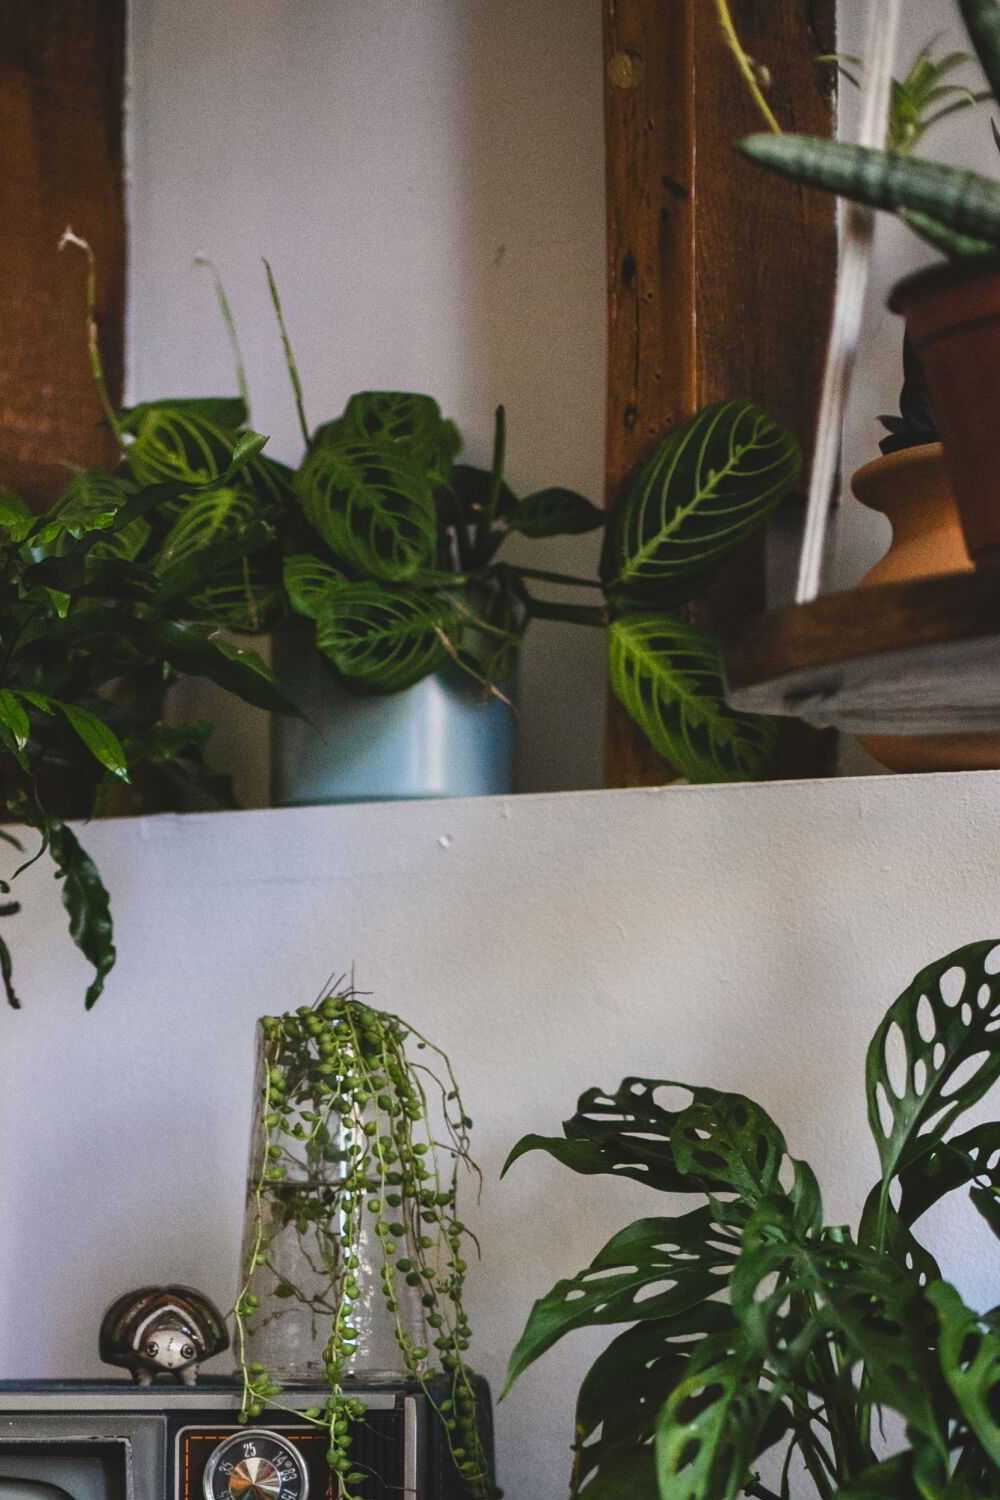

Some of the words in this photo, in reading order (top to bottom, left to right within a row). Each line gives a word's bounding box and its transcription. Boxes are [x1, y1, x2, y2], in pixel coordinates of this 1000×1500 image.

[243, 1441, 257, 1458] 25
[272, 1451, 287, 1467] 14
[218, 1460, 234, 1475] 35
[280, 1468, 297, 1482] 83
